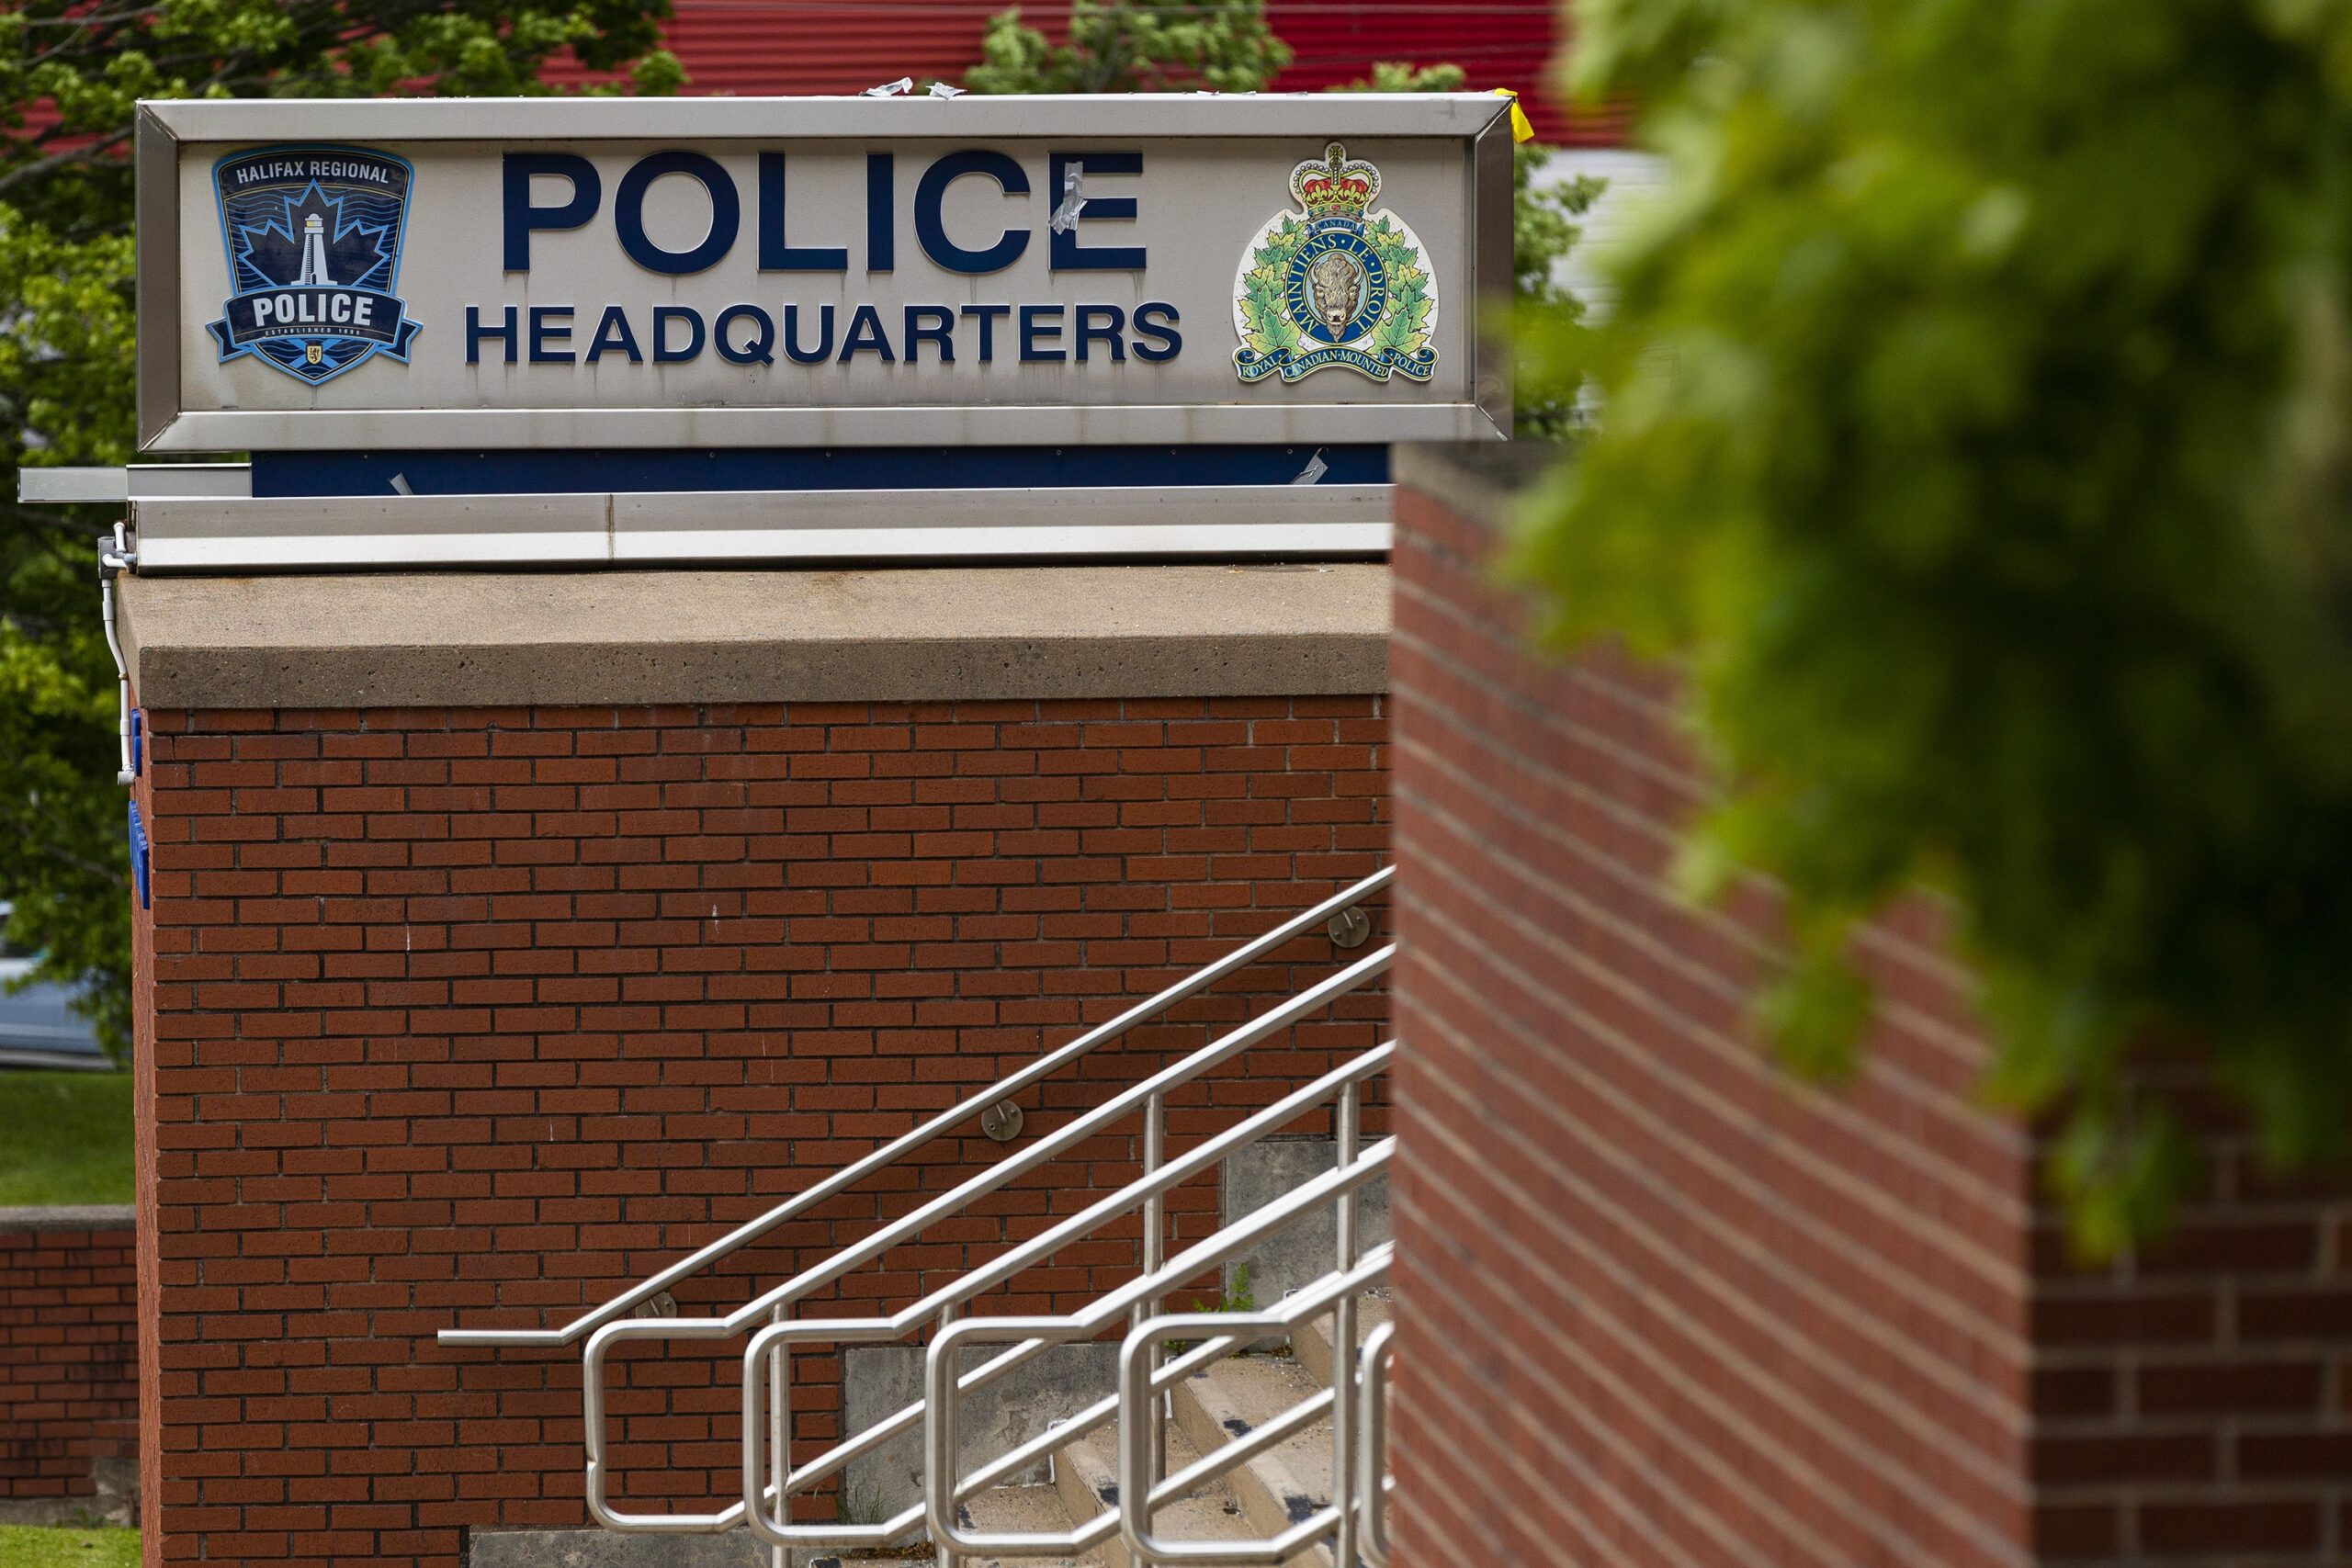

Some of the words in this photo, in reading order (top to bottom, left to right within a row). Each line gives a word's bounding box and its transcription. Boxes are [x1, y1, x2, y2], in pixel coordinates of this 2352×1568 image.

[236, 162, 305, 184] HALIFAX
[310, 161, 390, 184] REGIONAL
[503, 151, 1147, 275] POLICE
[1317, 220, 1356, 231] CANADA
[1349, 245, 1373, 263] LE
[1287, 233, 1338, 333] MAINTIENS
[253, 294, 374, 327] POLICE
[1359, 270, 1385, 334] DROIT
[265, 327, 332, 336] ESTABLISHED
[464, 301, 1182, 366] HEADQUARTERS
[1242, 355, 1278, 378] ROYAL
[1393, 353, 1430, 377] POLICE
